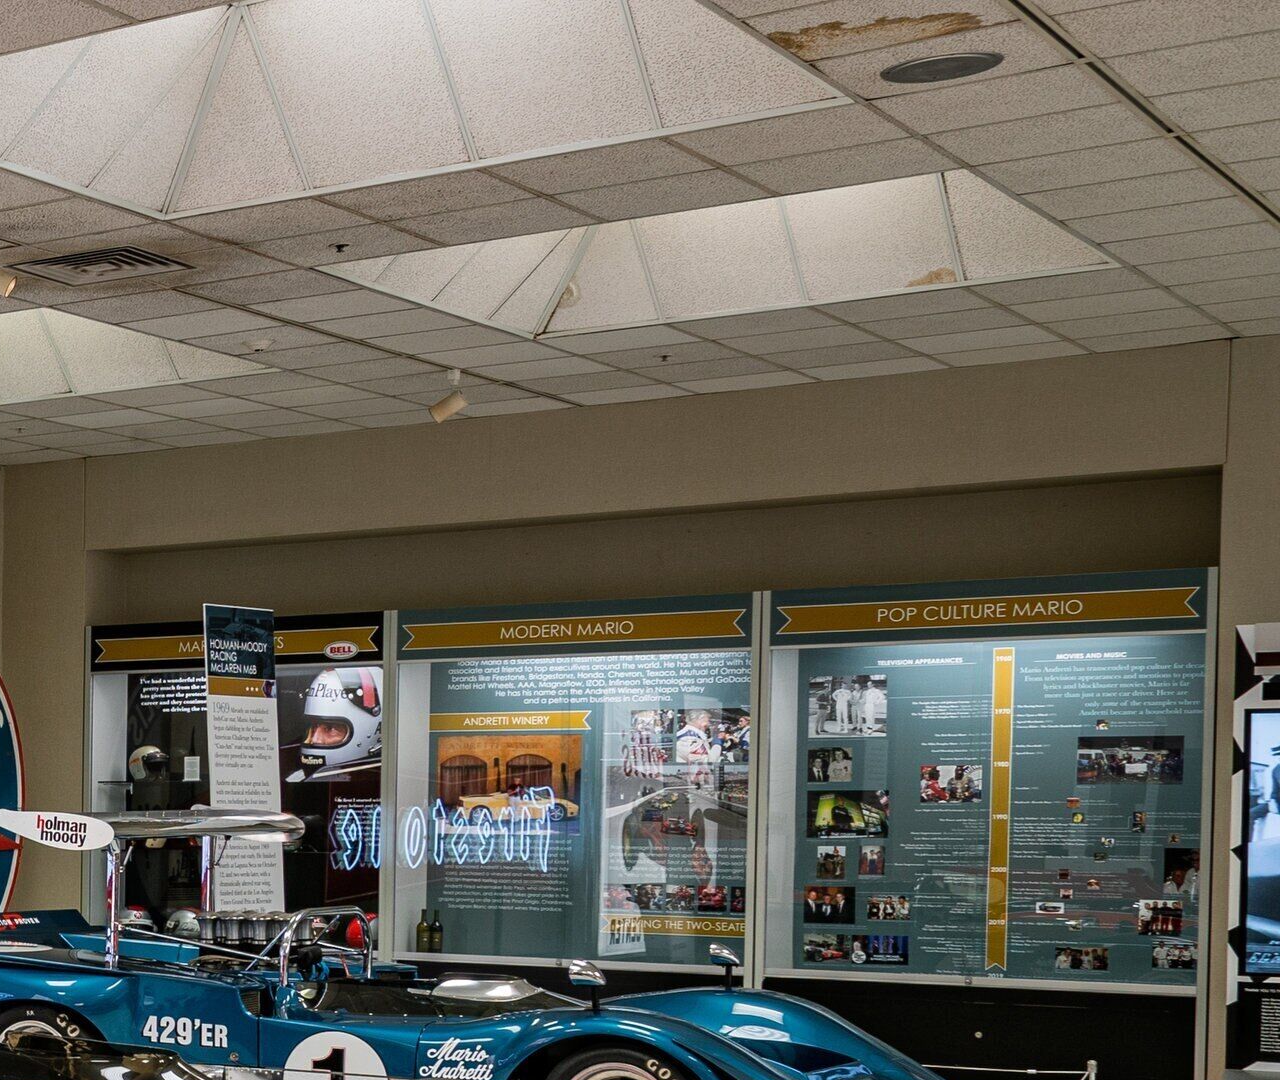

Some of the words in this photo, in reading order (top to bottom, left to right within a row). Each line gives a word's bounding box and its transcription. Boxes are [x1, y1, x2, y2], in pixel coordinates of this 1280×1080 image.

[877, 608, 917, 624] POP
[923, 603, 1007, 622] CULTURE
[1012, 599, 1083, 617] MARIO
[500, 623, 572, 640] MODERN
[577, 620, 634, 637] MARIO
[209, 638, 268, 653] HOLMAN-MOODY
[329, 645, 353, 655] BELL
[210, 650, 238, 662] RACING
[877, 658, 912, 666] TELEVISION
[914, 657, 963, 665] APPEARANCES
[1104, 651, 1127, 659] MUSIC
[210, 662, 242, 673] McLAREN
[243, 664, 257, 675] M6B
[213, 702, 230, 714] 1969
[463, 717, 508, 726] ANDRETTI
[511, 715, 550, 725] WINERY
[37, 815, 87, 833] holman
[40, 829, 86, 848] moody
[14, 917, 40, 927] PROVEN
[664, 918, 684, 930] THE
[686, 919, 746, 933] TWO-SEATE
[142, 1015, 229, 1049] 429'ER
[426, 1036, 491, 1063] Mario
